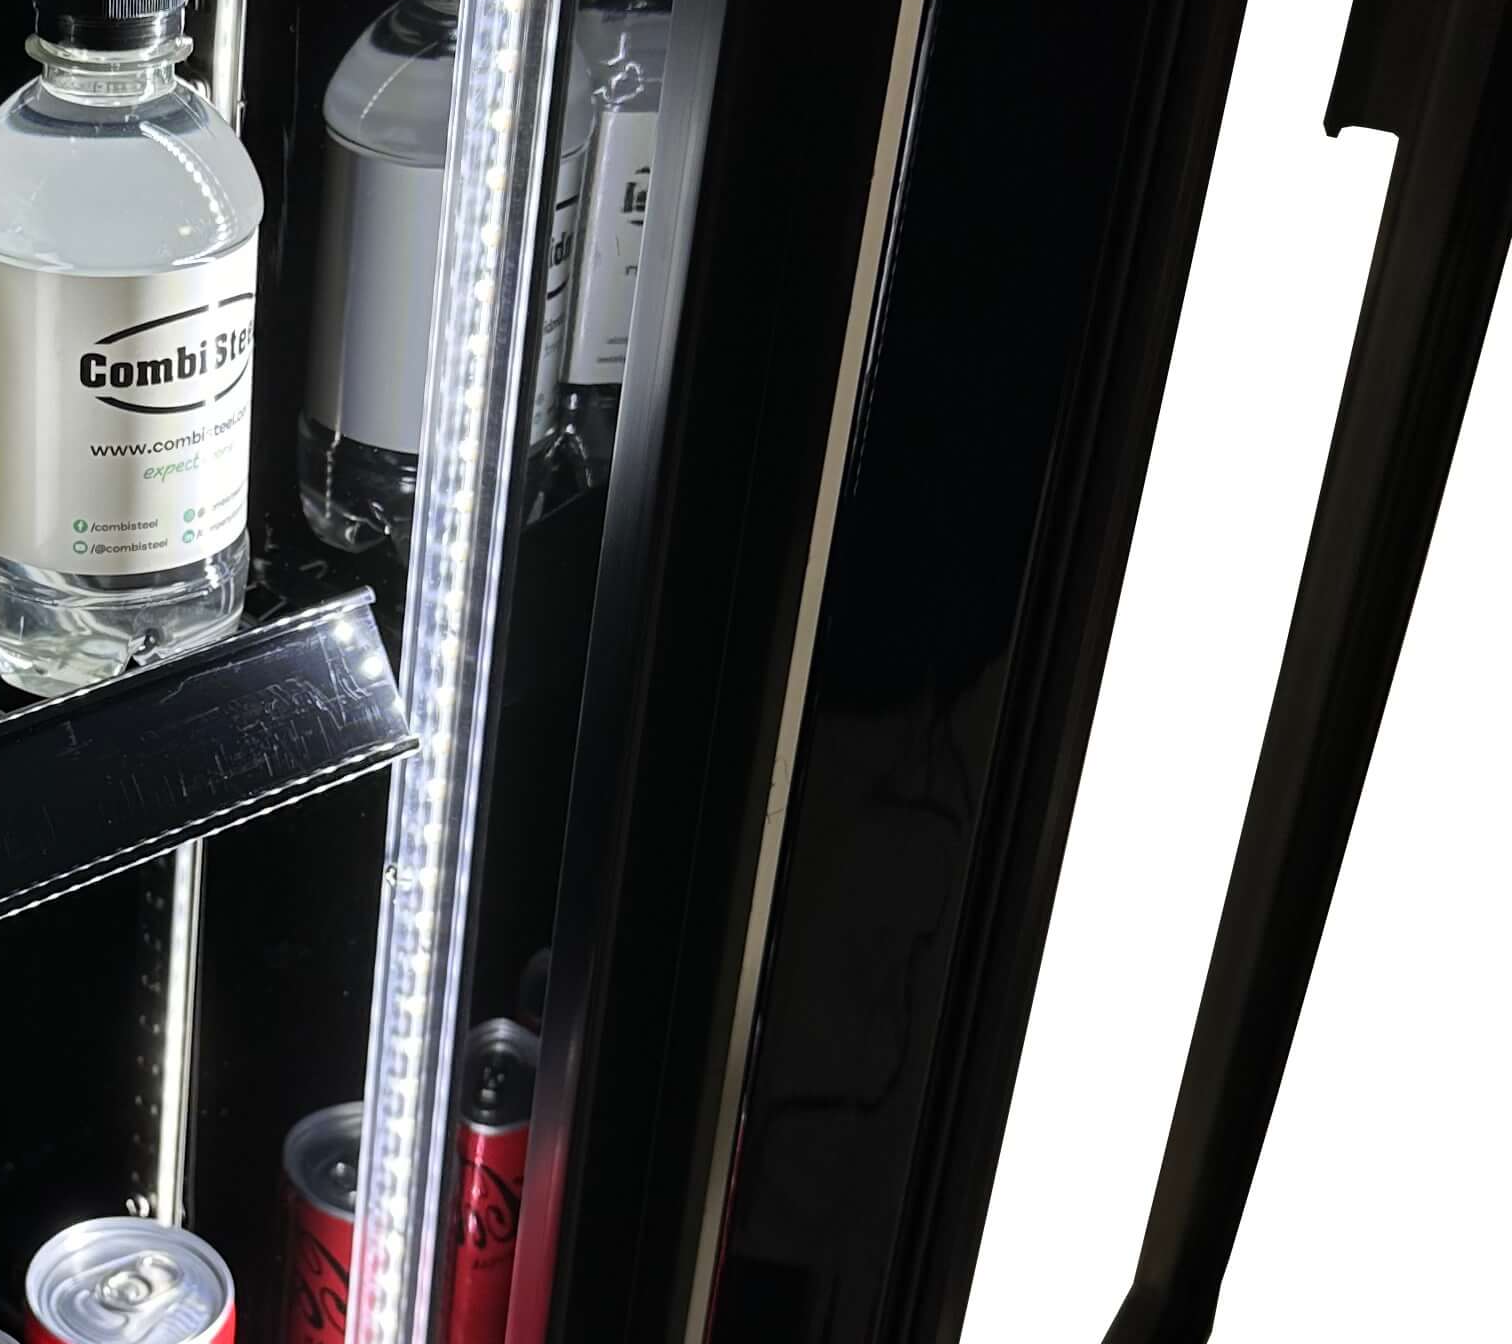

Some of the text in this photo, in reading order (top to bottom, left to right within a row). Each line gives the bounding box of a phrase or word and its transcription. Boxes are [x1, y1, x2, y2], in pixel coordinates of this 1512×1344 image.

[142, 452, 201, 484] expect
[90, 518, 160, 534] /combisteel
[90, 538, 170, 556] /@combisteel
